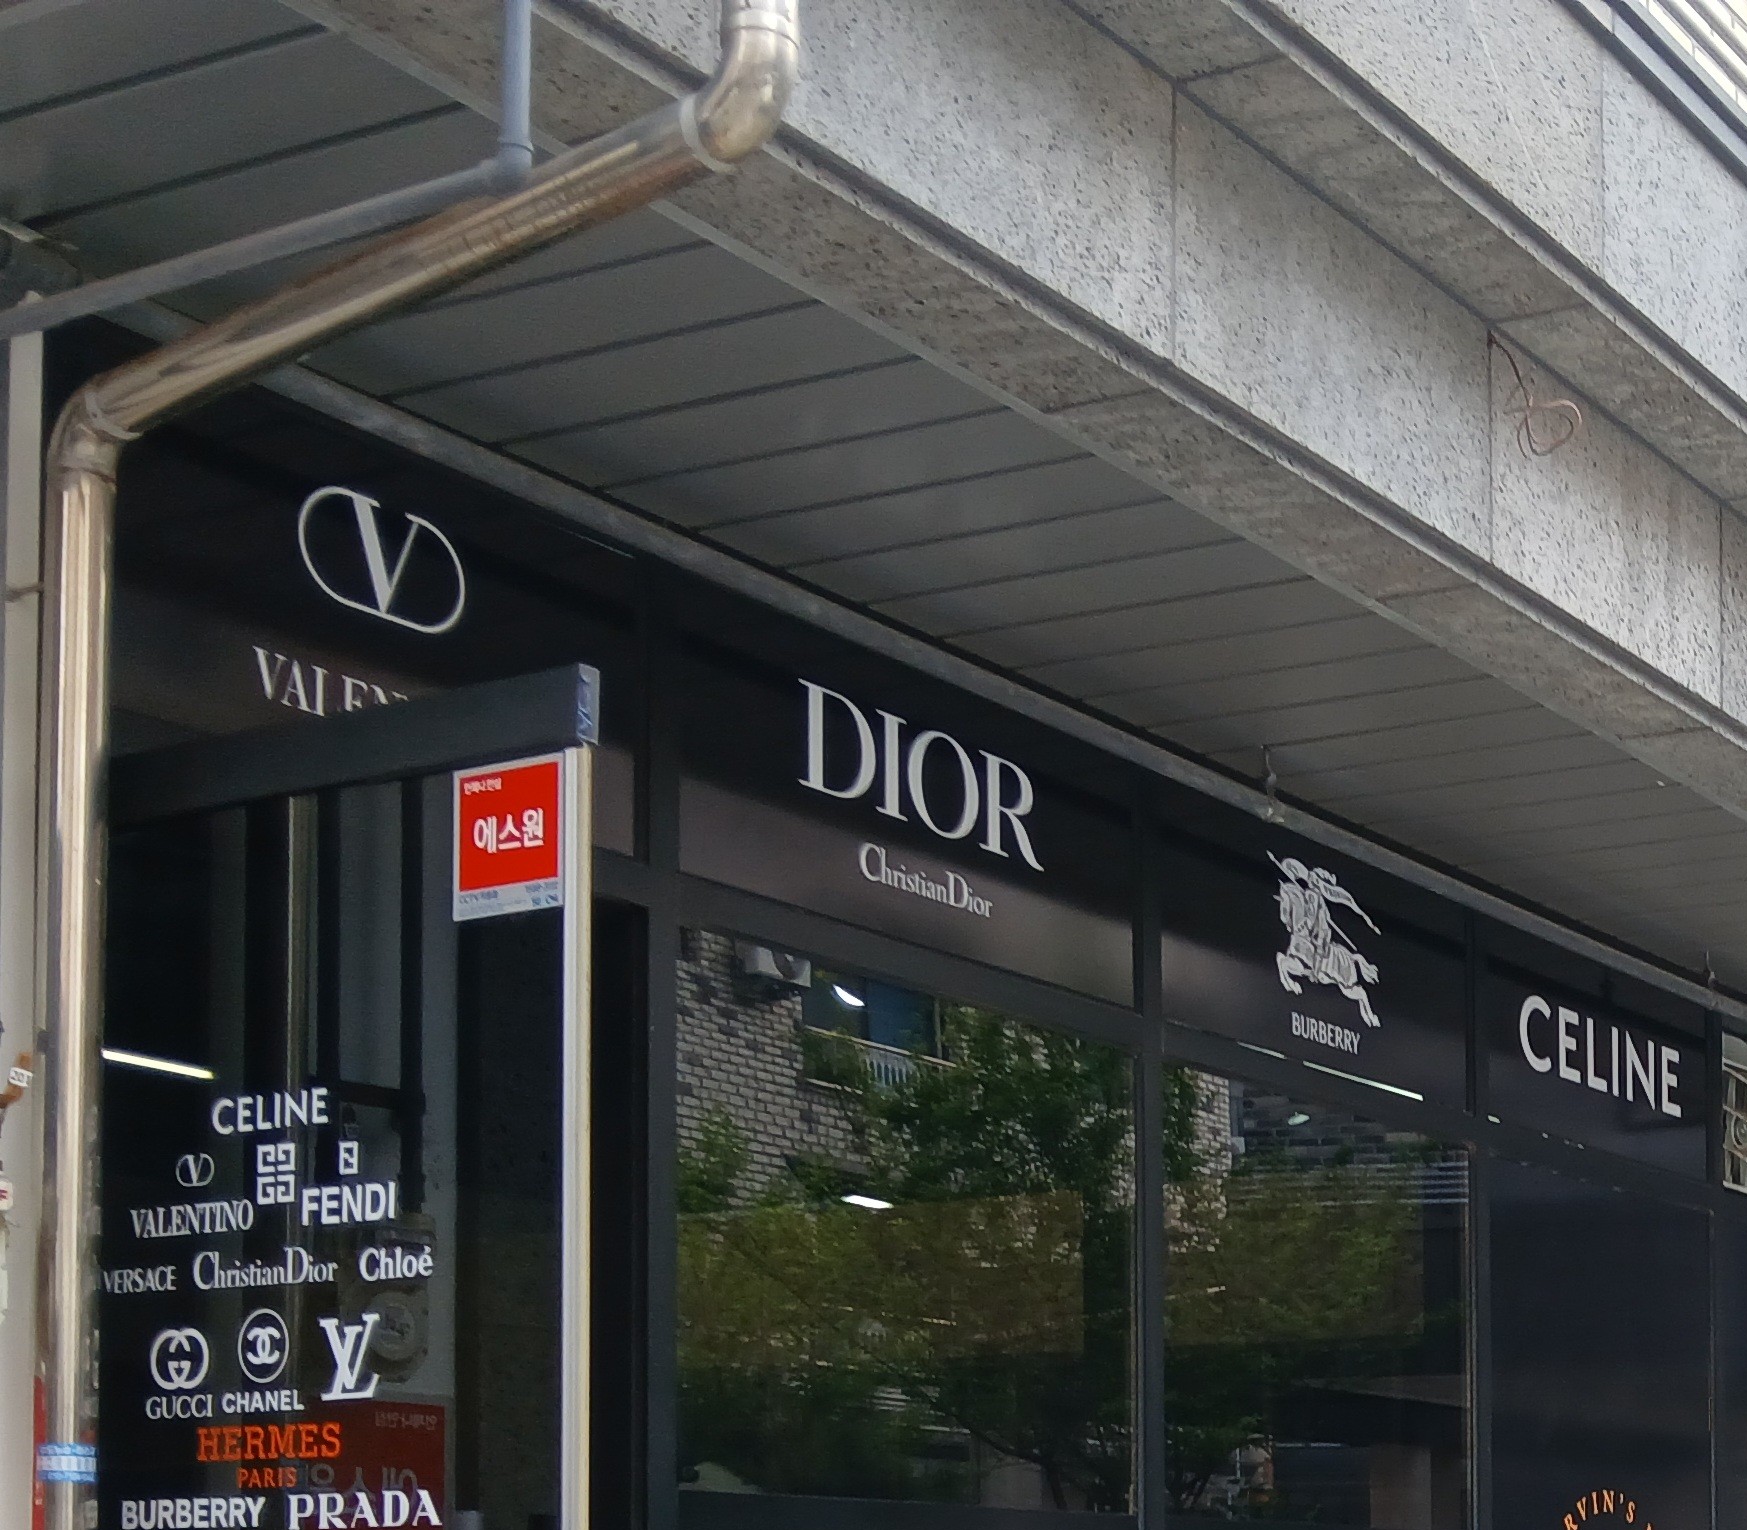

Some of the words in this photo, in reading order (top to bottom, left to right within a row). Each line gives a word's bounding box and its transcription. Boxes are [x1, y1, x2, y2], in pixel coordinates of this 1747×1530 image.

[798, 678, 1045, 873] DIOR
[473, 807, 544, 854] 에스원
[1291, 1010, 1361, 1055] BURBERRY
[1518, 994, 1683, 1118] CELINE
[212, 1087, 329, 1135] CELINE
[130, 1198, 254, 1239] VALENTINO
[301, 1181, 396, 1226] FENDI
[103, 1264, 177, 1294] VERSACE
[359, 1245, 434, 1282] Chloé
[145, 1393, 213, 1420] GUCCI
[221, 1388, 305, 1414] CHANEL
[196, 1422, 342, 1462] HERMES
[237, 1466, 297, 1489] PARIS
[121, 1496, 266, 1530] BURBERRY
[287, 1489, 443, 1530] PRADA
